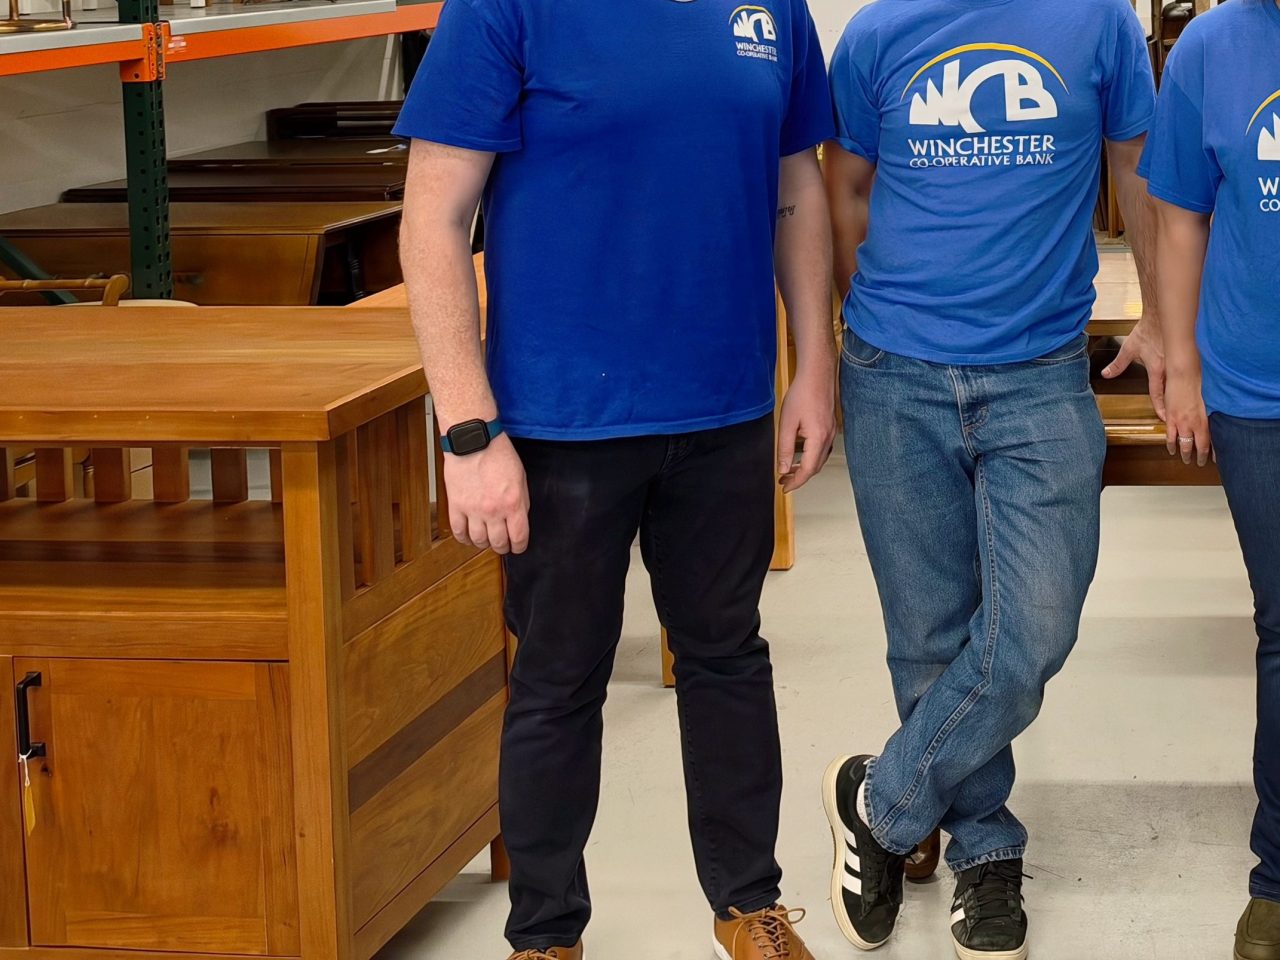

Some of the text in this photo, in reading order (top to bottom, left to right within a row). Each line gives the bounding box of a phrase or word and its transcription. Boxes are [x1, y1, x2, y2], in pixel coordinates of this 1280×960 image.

[908, 135, 1056, 157] WINCHESTER
[909, 152, 1055, 168] CO-OPERATIVE BANK
